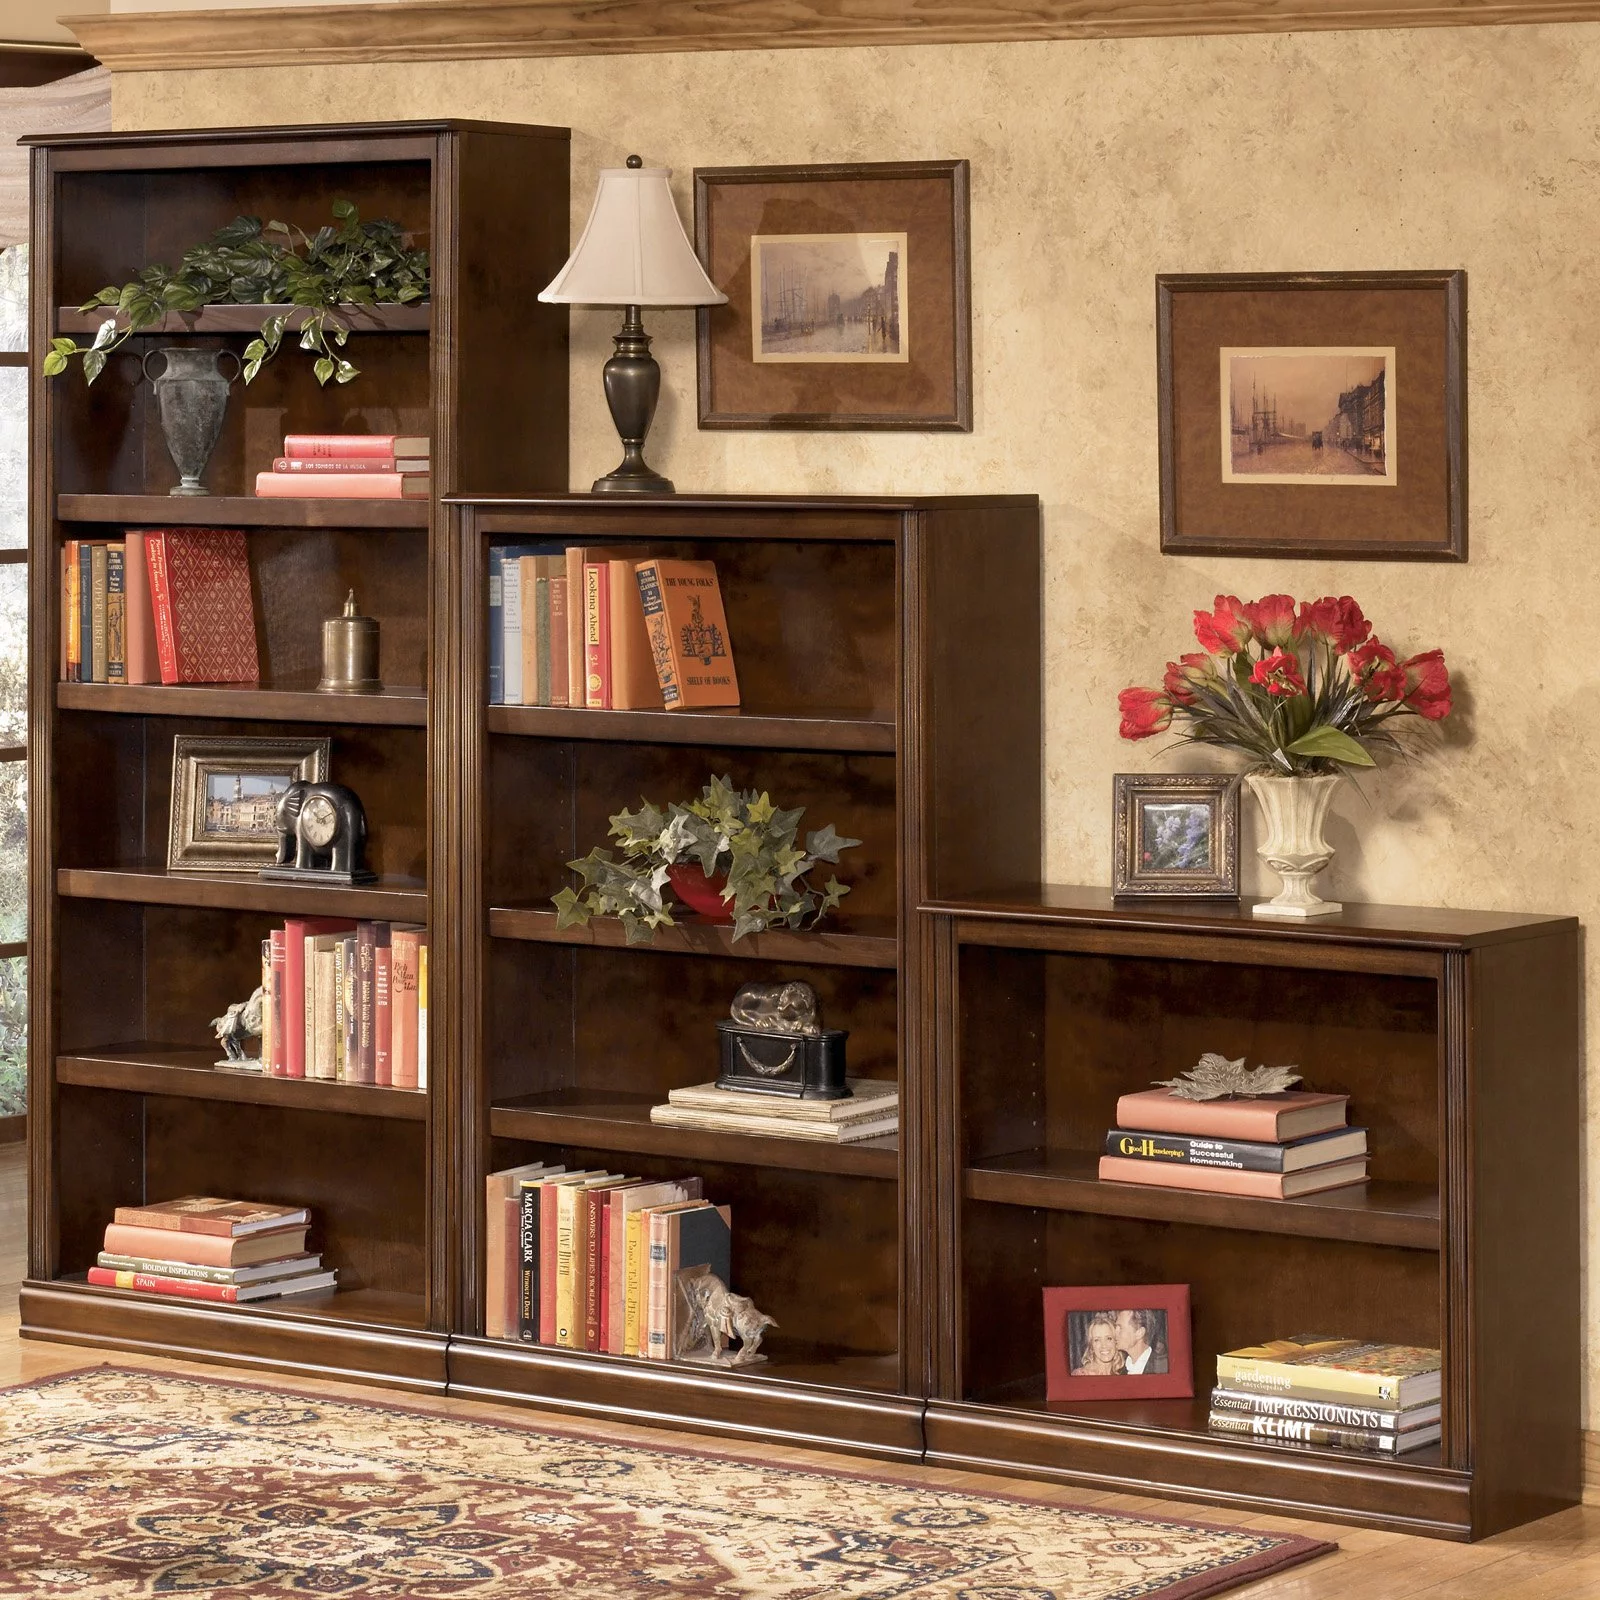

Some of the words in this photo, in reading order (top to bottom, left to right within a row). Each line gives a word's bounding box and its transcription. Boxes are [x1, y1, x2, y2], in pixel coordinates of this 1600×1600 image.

[149, 539, 157, 561] Cooking
[588, 571, 598, 610] Looking
[665, 578, 676, 586] THE
[678, 578, 695, 586] YOUNG
[95, 578, 103, 610] VIPER
[94, 611, 103, 649] THREE
[589, 612, 598, 643] Ahead
[686, 677, 703, 685] SHELF
[704, 676, 712, 685] OF
[712, 676, 730, 685] BOOKS
[336, 972, 343, 983] TO
[1119, 1137, 1142, 1155] Good
[1189, 1140, 1214, 1150] Guide
[1214, 1142, 1224, 1150] to
[1189, 1149, 1234, 1160] Successful
[1189, 1157, 1243, 1169] Homemaking
[523, 1192, 533, 1230] MARCIA
[523, 1231, 533, 1263] CLARK
[589, 1240, 595, 1252] TO
[627, 1240, 637, 1266] Papa's
[142, 1263, 168, 1273] HOLIDAY
[168, 1266, 209, 1279] INSPIRATIONS
[558, 1250, 572, 1276] RIVER
[135, 1278, 156, 1288] SPAIN
[627, 1269, 637, 1295] Table
[1234, 1367, 1291, 1389] gardening
[1242, 1381, 1283, 1391] encyclopedia
[1213, 1396, 1252, 1411] Essential
[1253, 1400, 1379, 1428] IMPRESSIONISTS
[1212, 1418, 1250, 1431] Essential
[1252, 1415, 1315, 1441] KLIMT
